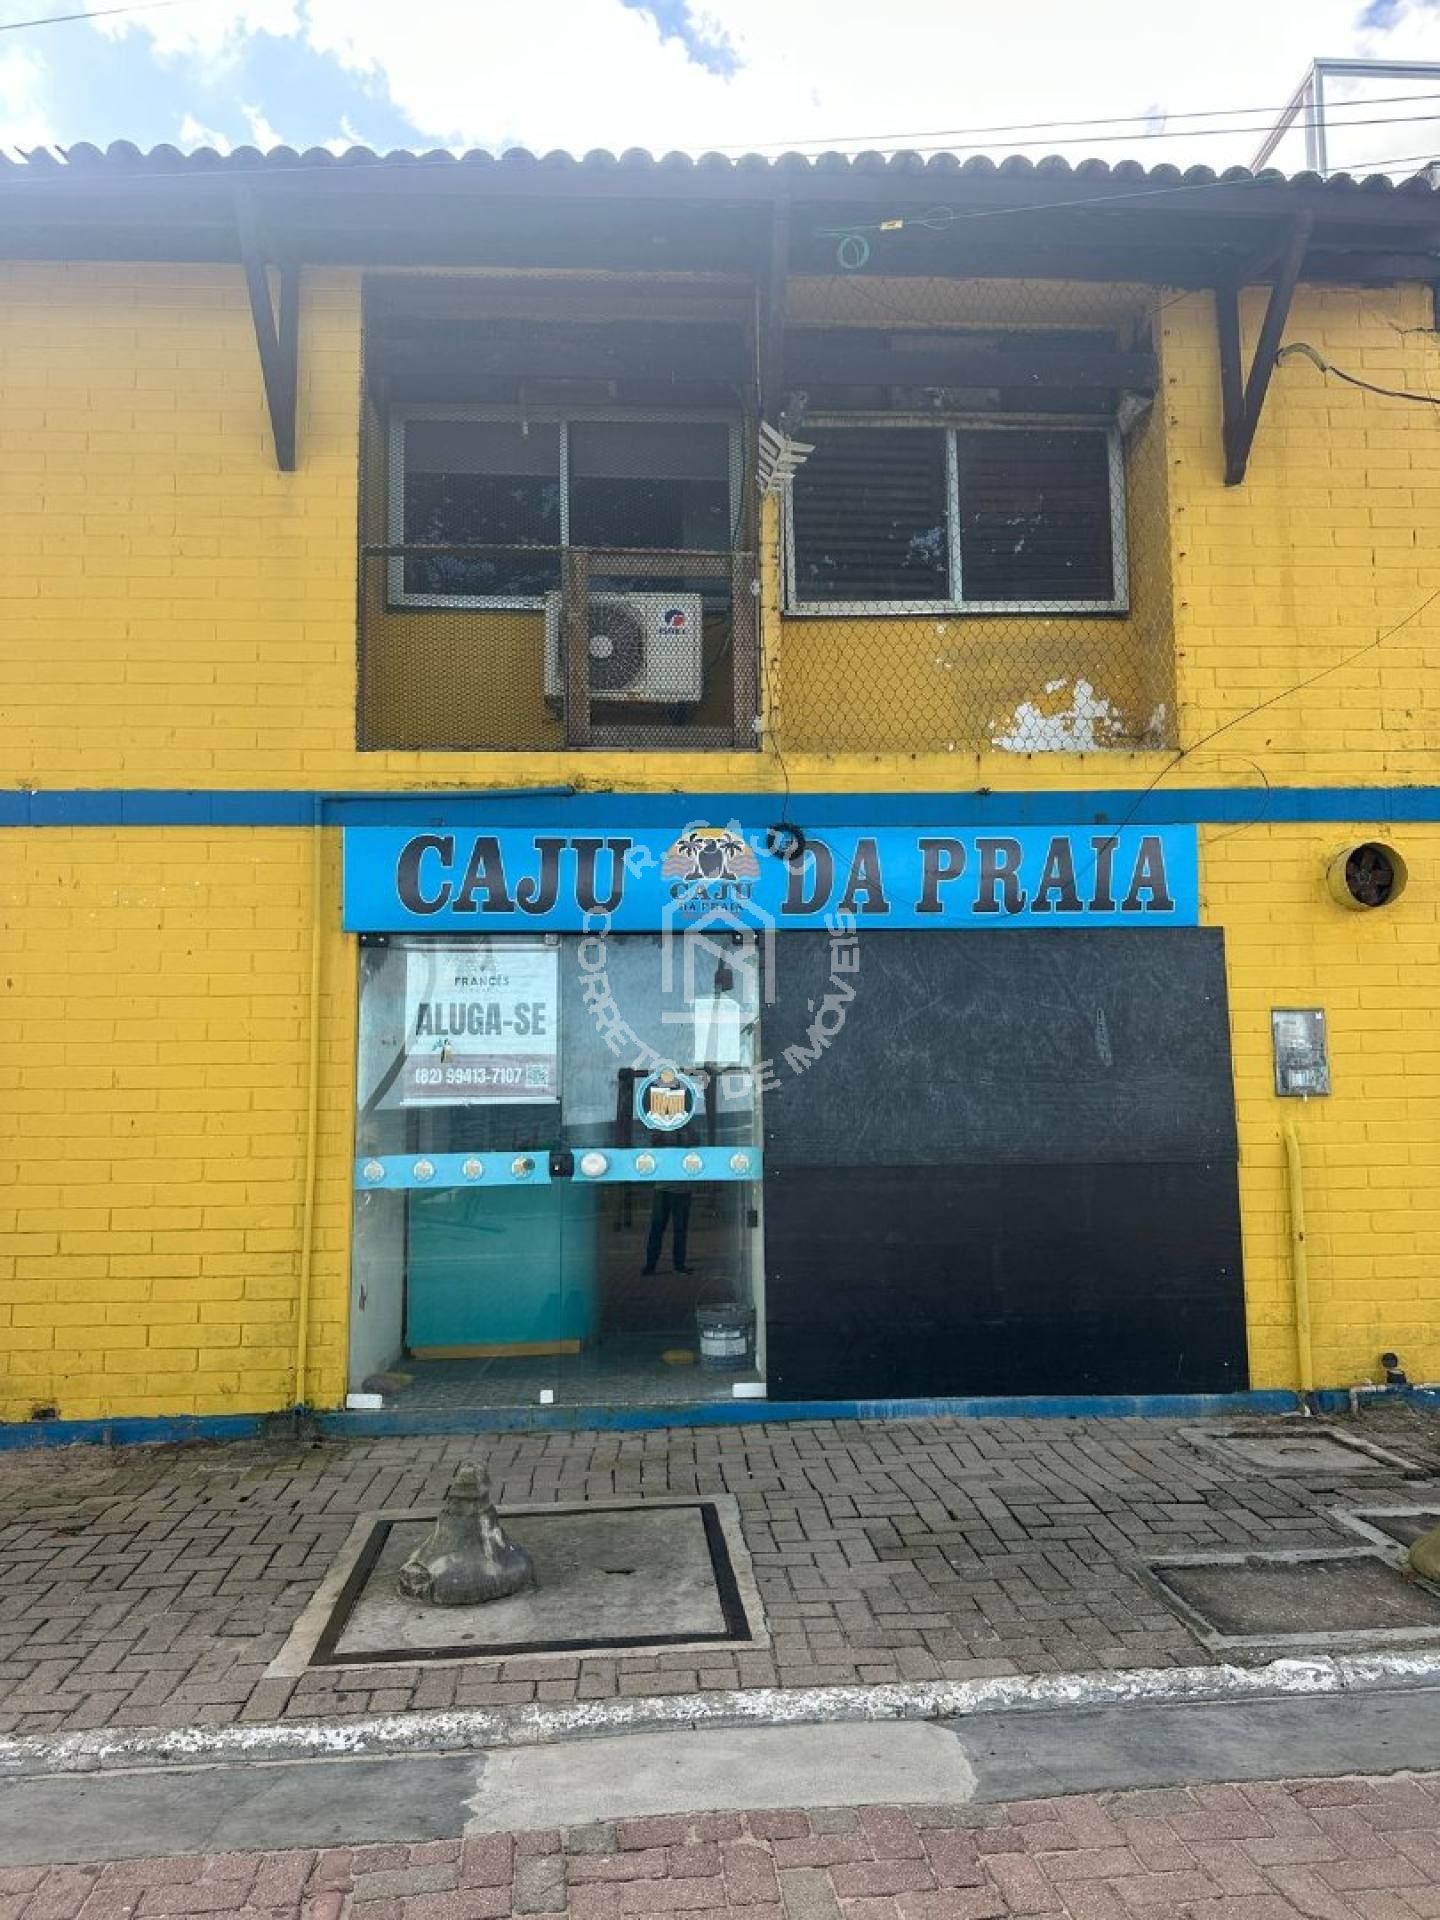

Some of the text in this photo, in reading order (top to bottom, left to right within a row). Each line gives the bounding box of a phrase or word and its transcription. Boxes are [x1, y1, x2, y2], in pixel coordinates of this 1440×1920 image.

[396, 834, 1176, 915] CAJU DA PRAIA
[669, 880, 753, 901] CAJU
[415, 1002, 547, 1036] ALUGA-SE
